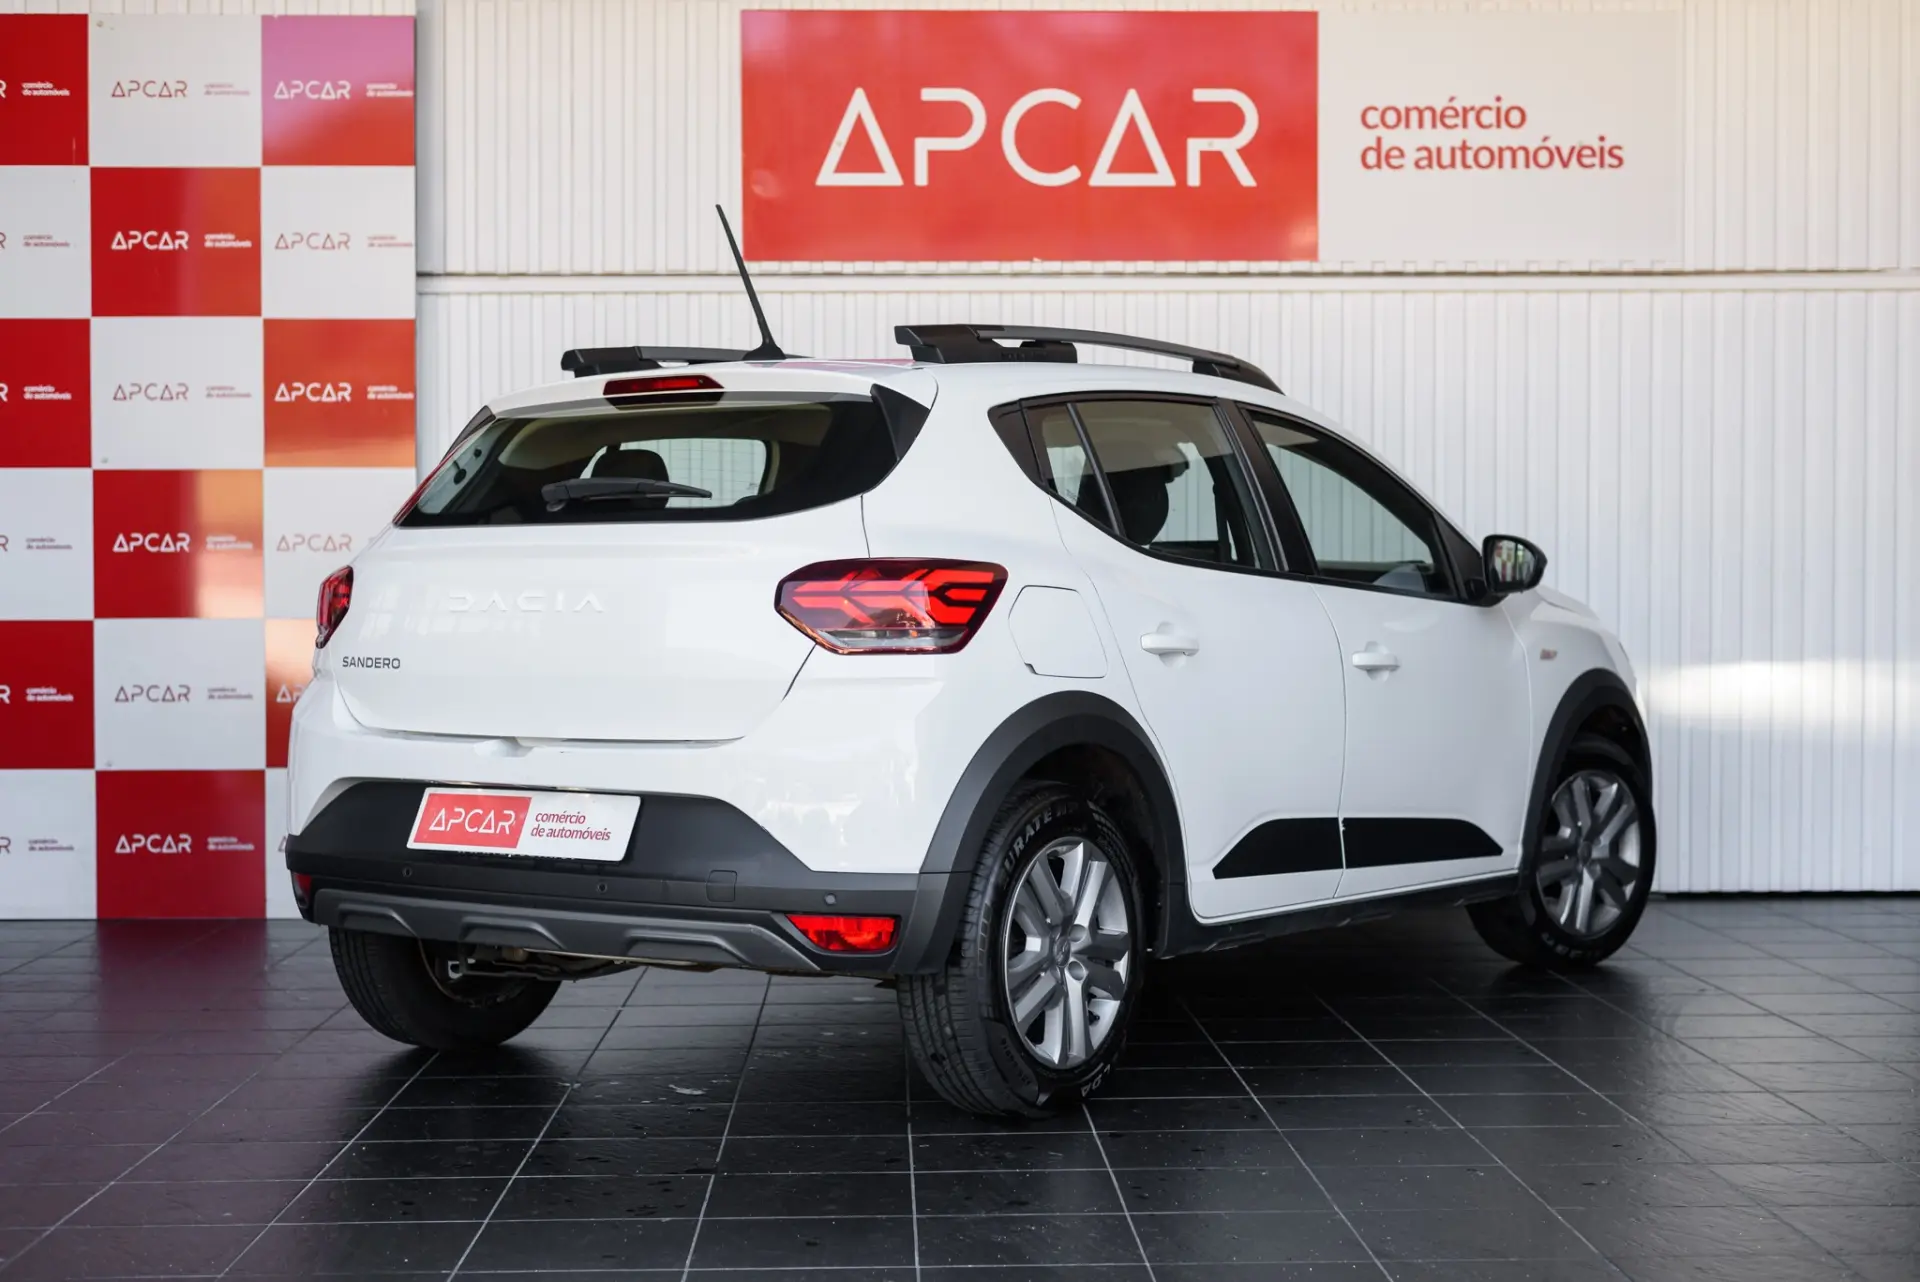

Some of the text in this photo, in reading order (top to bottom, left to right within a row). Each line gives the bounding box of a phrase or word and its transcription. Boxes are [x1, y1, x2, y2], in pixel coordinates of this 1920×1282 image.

[111, 80, 187, 98] APCAR
[274, 80, 352, 100] APCAR
[1361, 96, 1526, 128] comércio
[816, 88, 1258, 187] APCAR
[1361, 138, 1624, 169] de automóveis
[111, 231, 189, 250] APCAR
[274, 232, 350, 250] APCAR
[113, 383, 189, 401] APCAR
[275, 382, 352, 402] APCAR
[112, 532, 192, 553] APCAR
[276, 534, 353, 553] APCAR
[448, 589, 605, 613] DACIA
[342, 655, 401, 670] SANDERO
[115, 685, 190, 703] APCAR
[428, 807, 516, 835] APCAR
[535, 810, 587, 826] comércio
[531, 824, 612, 842] de automóveis
[115, 833, 192, 853] APCAR
